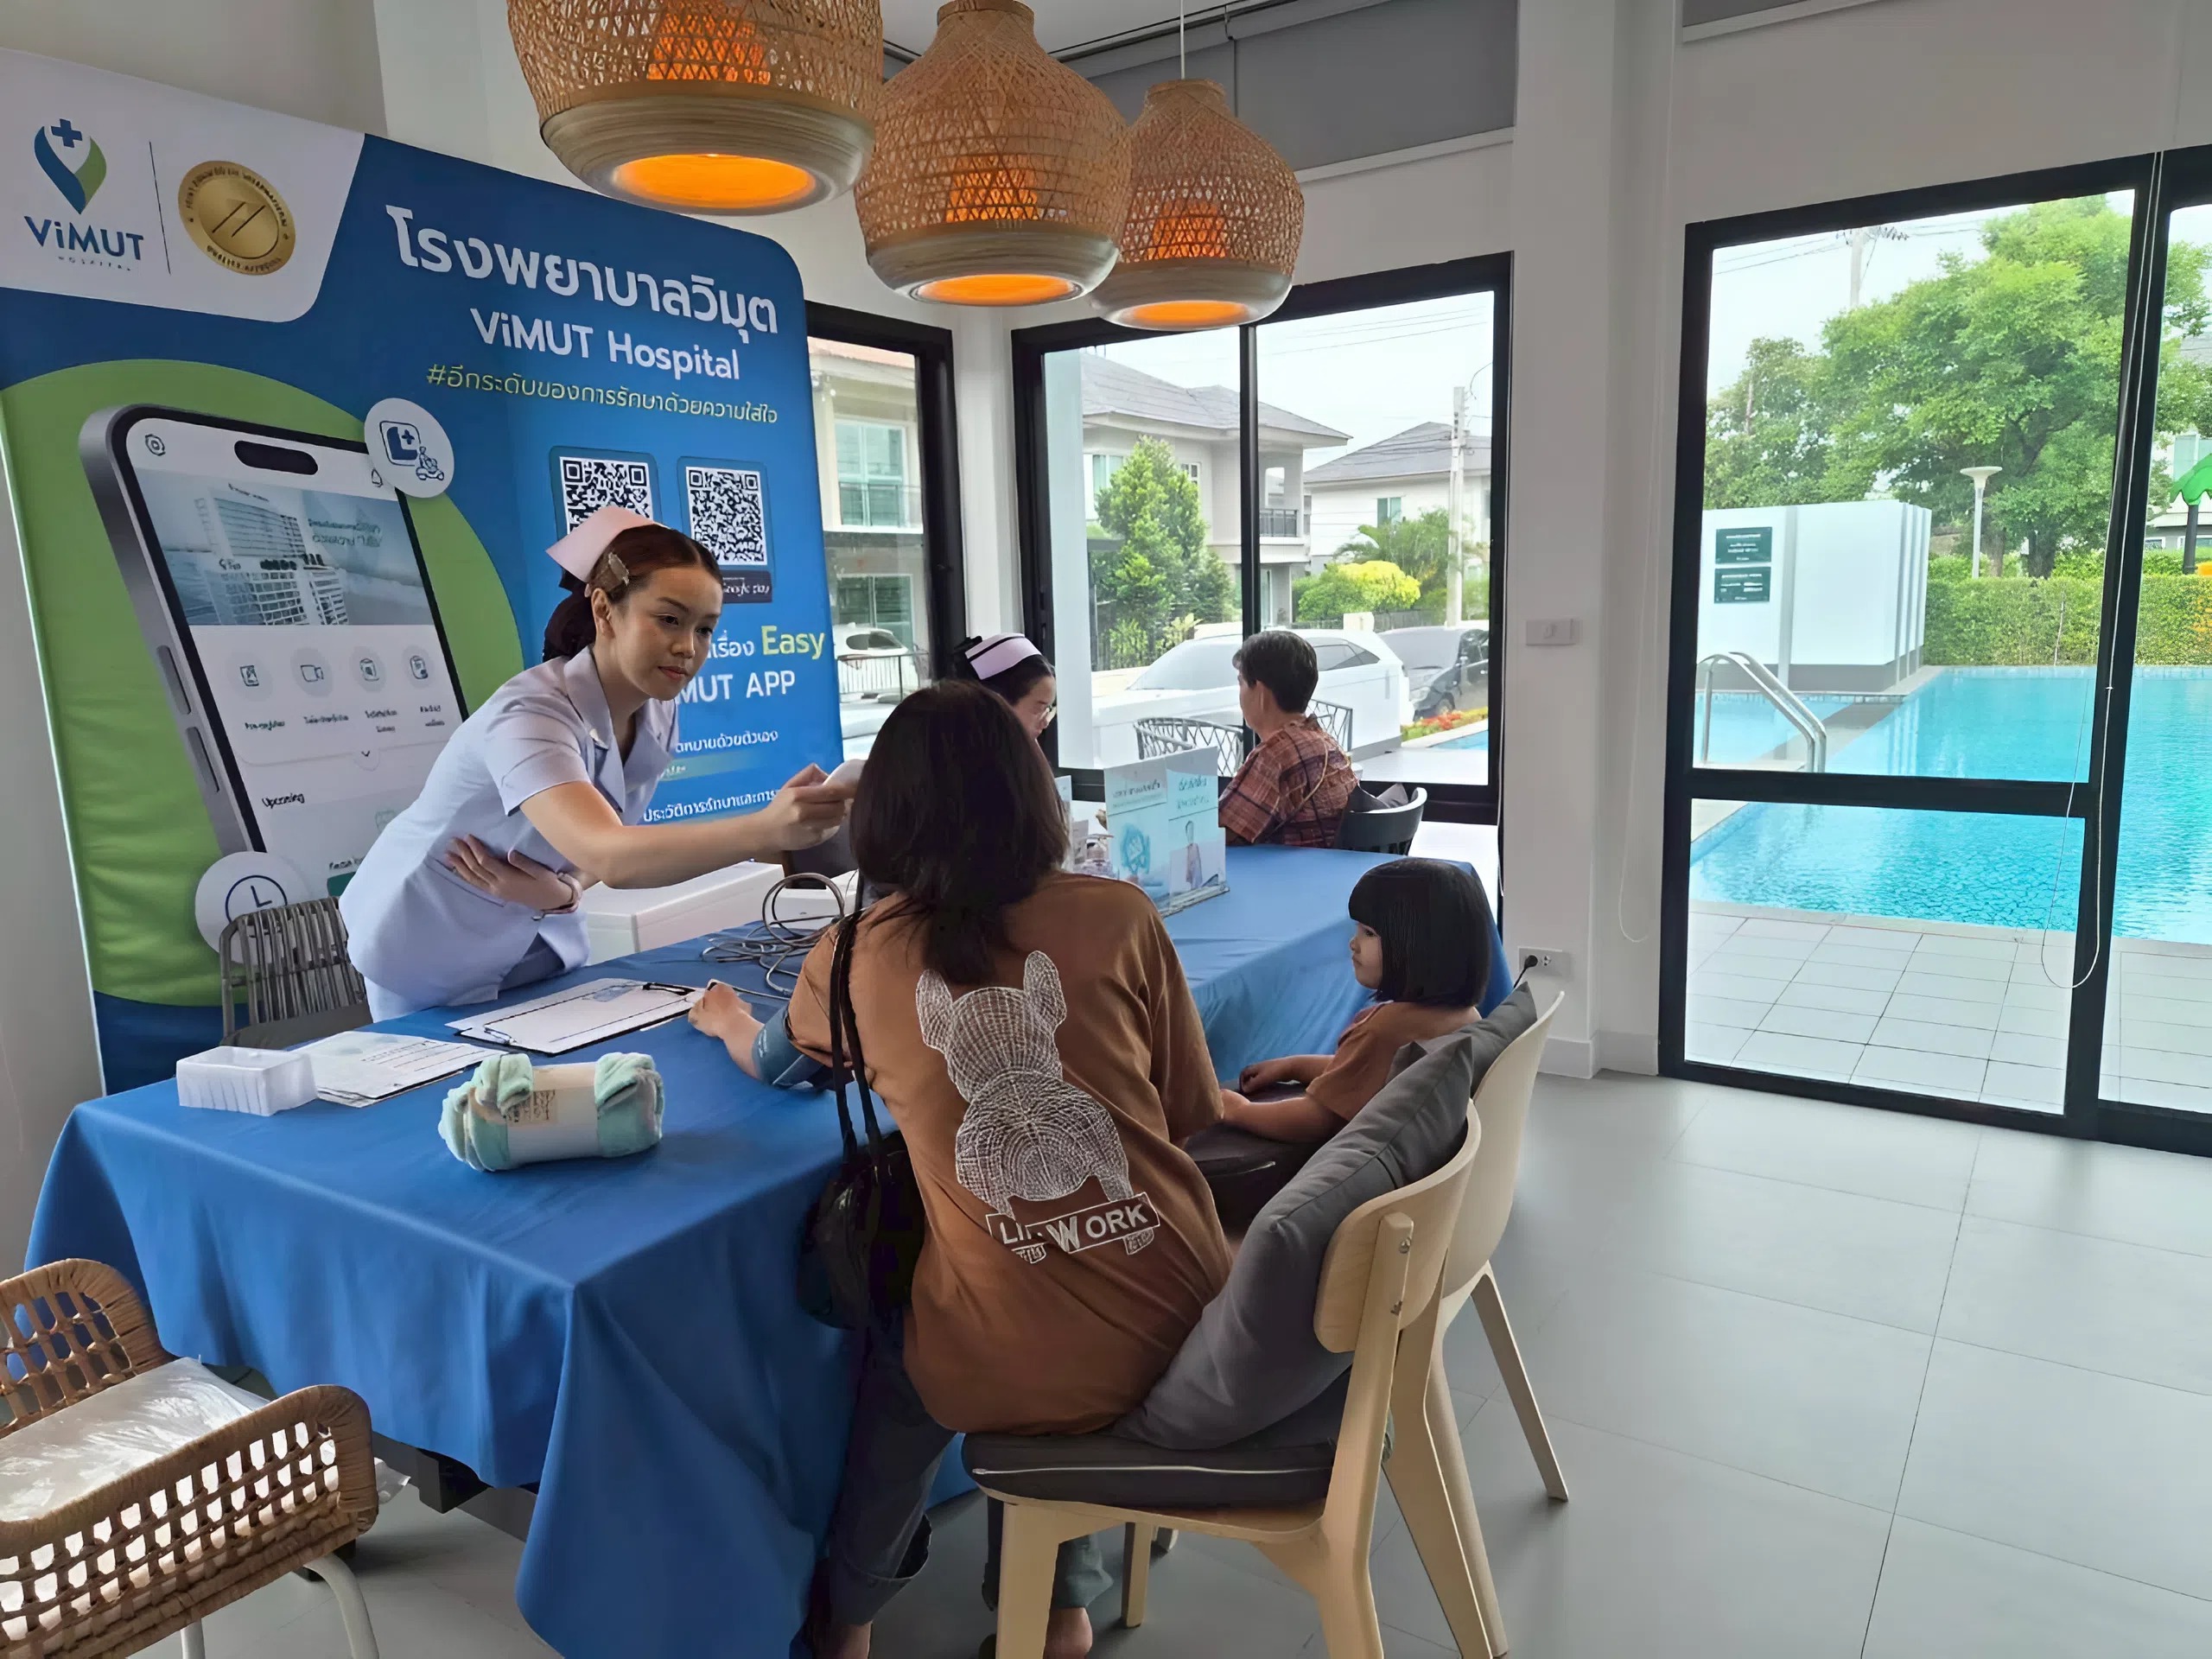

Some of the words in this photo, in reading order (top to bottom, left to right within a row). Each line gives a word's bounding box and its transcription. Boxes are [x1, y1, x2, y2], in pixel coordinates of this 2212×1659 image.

[24, 215, 144, 260] ViMUT
[385, 204, 779, 344] โรงพยาบาลวิมุต
[470, 308, 594, 359] ViMUT
[607, 330, 741, 380] Hospital
[426, 363, 779, 424] #อีกระดับของการรักษาด้วยความใส่ใจ
[708, 629, 755, 658] เรื่อง
[760, 625, 825, 660] Easy
[675, 674, 734, 705] MUT
[746, 670, 796, 698] APP
[675, 729, 779, 753] ดหมายด้วยตัวเอง
